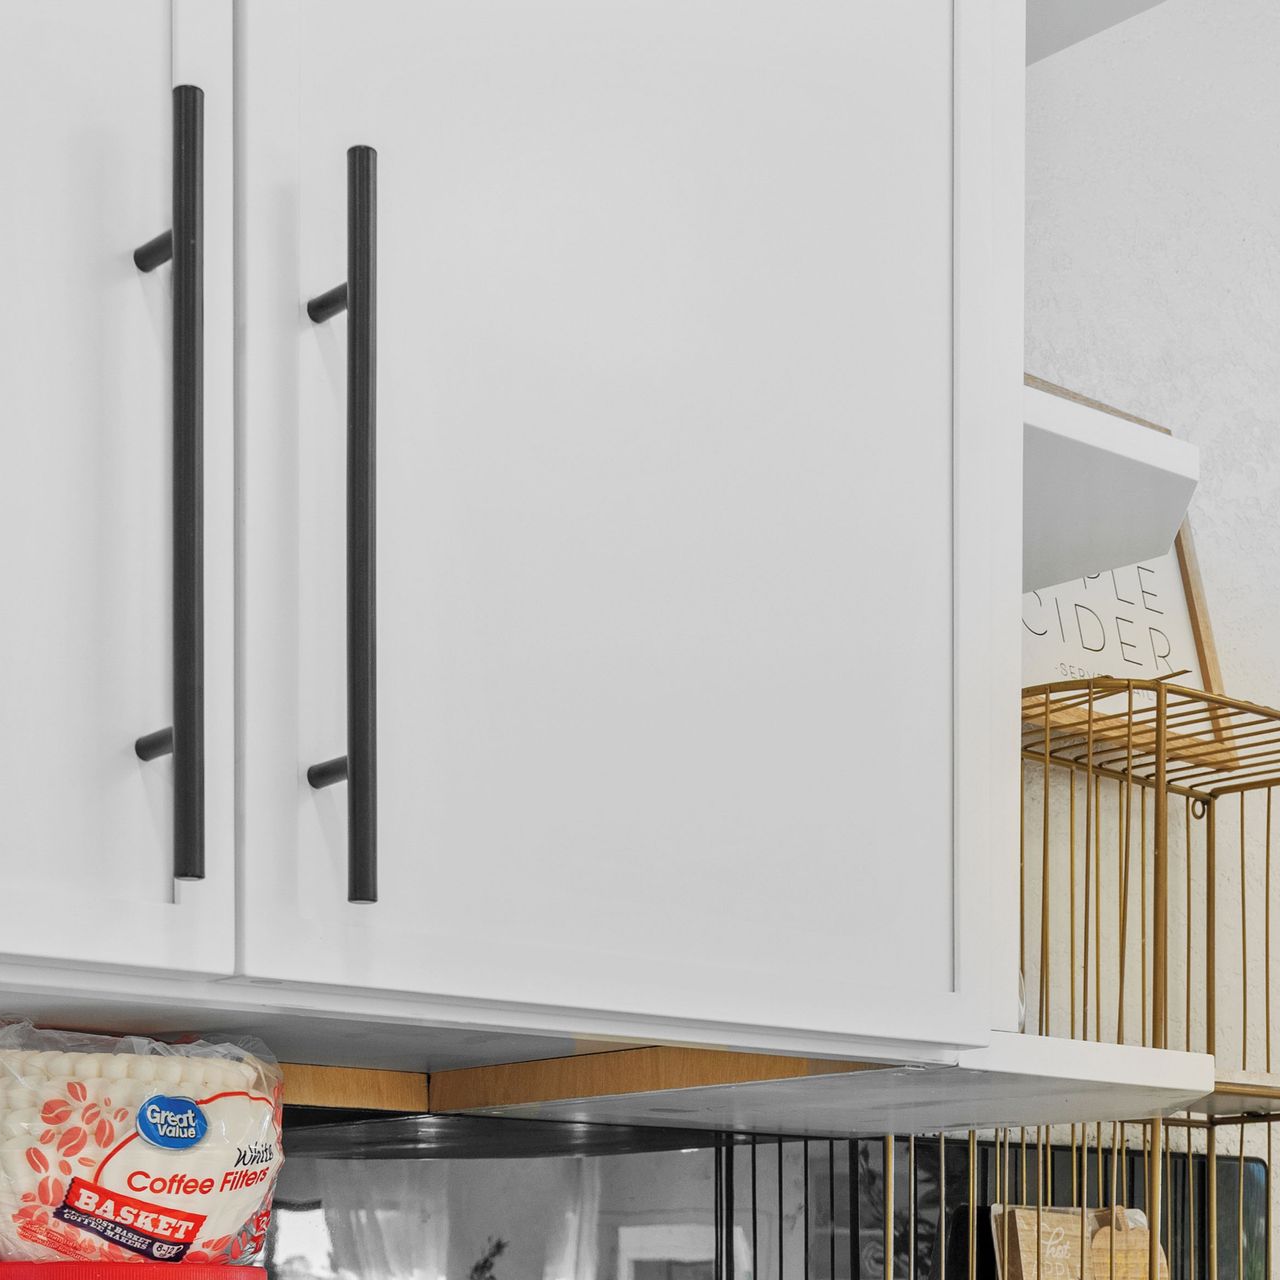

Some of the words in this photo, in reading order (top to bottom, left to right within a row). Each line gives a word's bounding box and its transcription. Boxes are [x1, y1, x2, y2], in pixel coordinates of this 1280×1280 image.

[147, 1104, 197, 1129] Great
[158, 1122, 196, 1139] Value
[126, 1169, 214, 1195] Coffee
[219, 1166, 270, 1192] Filters
[75, 1189, 195, 1240] BASKET
[63, 1212, 106, 1233] COFFEE
[104, 1230, 149, 1251] MAKERS
